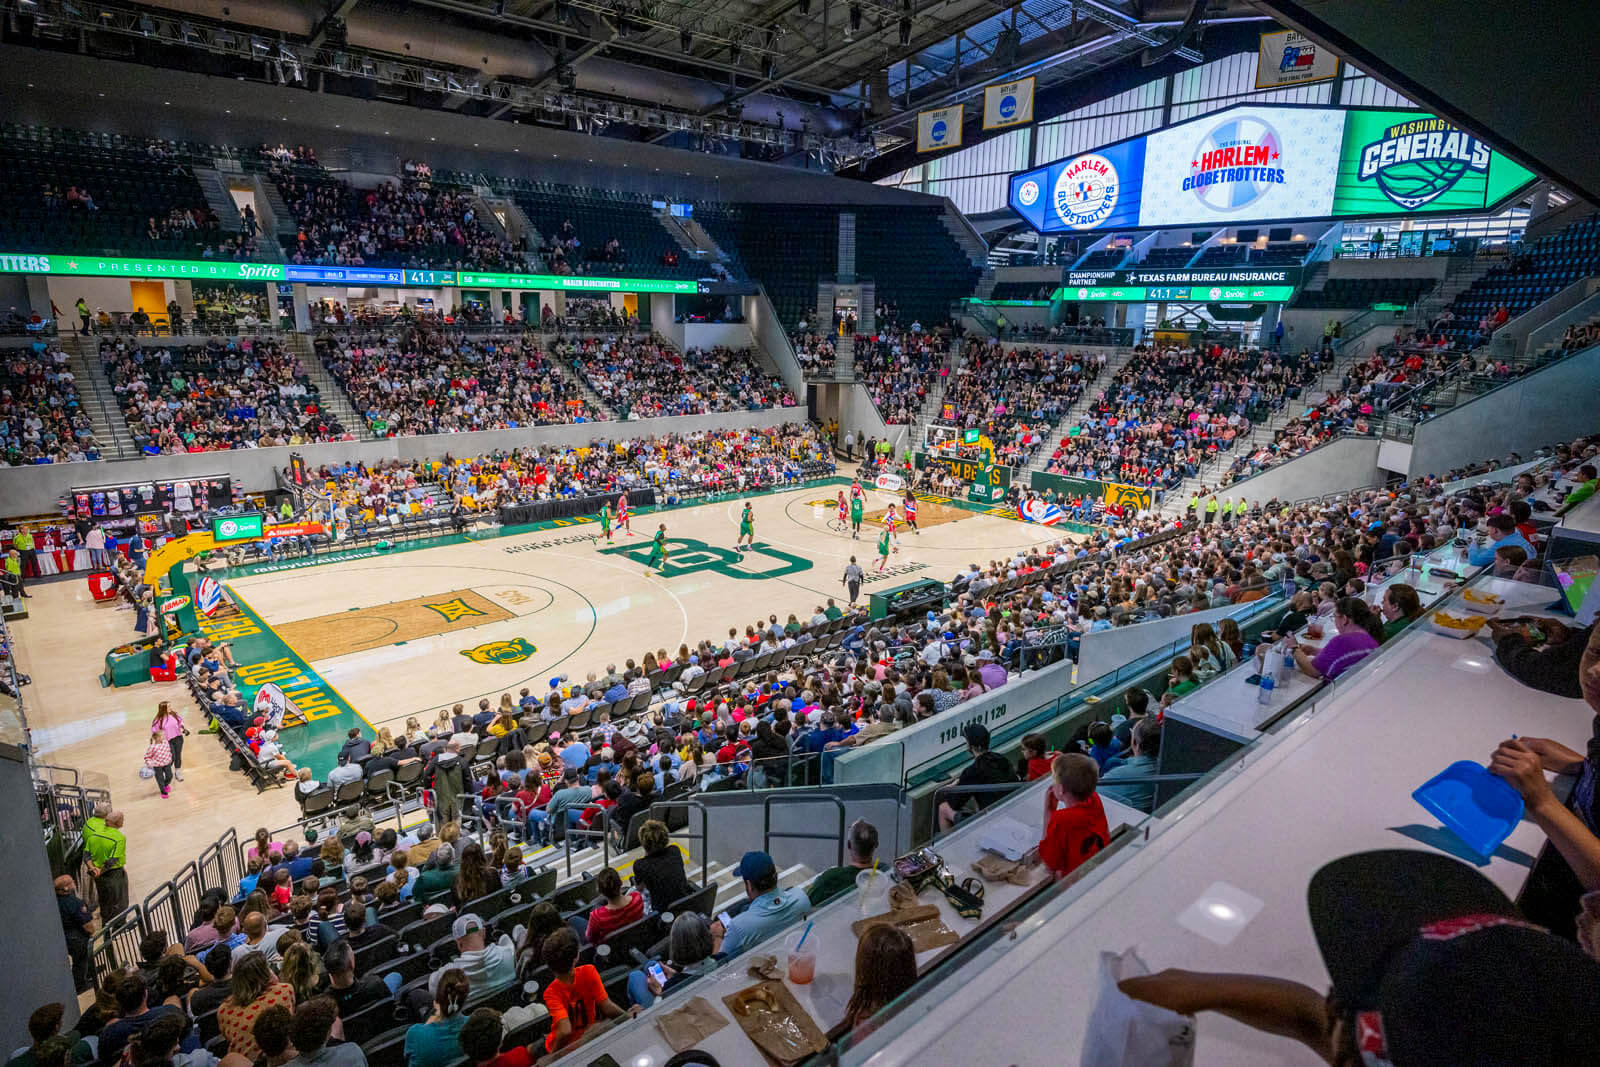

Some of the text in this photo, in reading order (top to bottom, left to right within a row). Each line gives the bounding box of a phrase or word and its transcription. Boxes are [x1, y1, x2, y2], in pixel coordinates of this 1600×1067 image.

[1390, 119, 1459, 139] WASHINGT
[1201, 145, 1270, 172] HARLEM
[1361, 132, 1491, 178] GENERALS
[1066, 160, 1109, 179] HARLEM
[1182, 167, 1286, 192] GLOBETROTTERS
[1057, 184, 1115, 225] GLOBETROTTERS
[98, 262, 199, 273] PRESENTED
[209, 266, 227, 274] BY
[238, 264, 280, 279] Sprite
[411, 272, 435, 283] 41.1
[1069, 271, 1116, 279] CHAMPIONSHIP
[1138, 272, 1286, 282] TEXAS FARM BUREAU INSURANCE
[1068, 278, 1097, 286] PARTNER
[1150, 288, 1170, 299] 41.1
[160, 596, 188, 614] LIBMAN
[940, 726, 958, 744] 118
[991, 703, 1007, 721] 120
